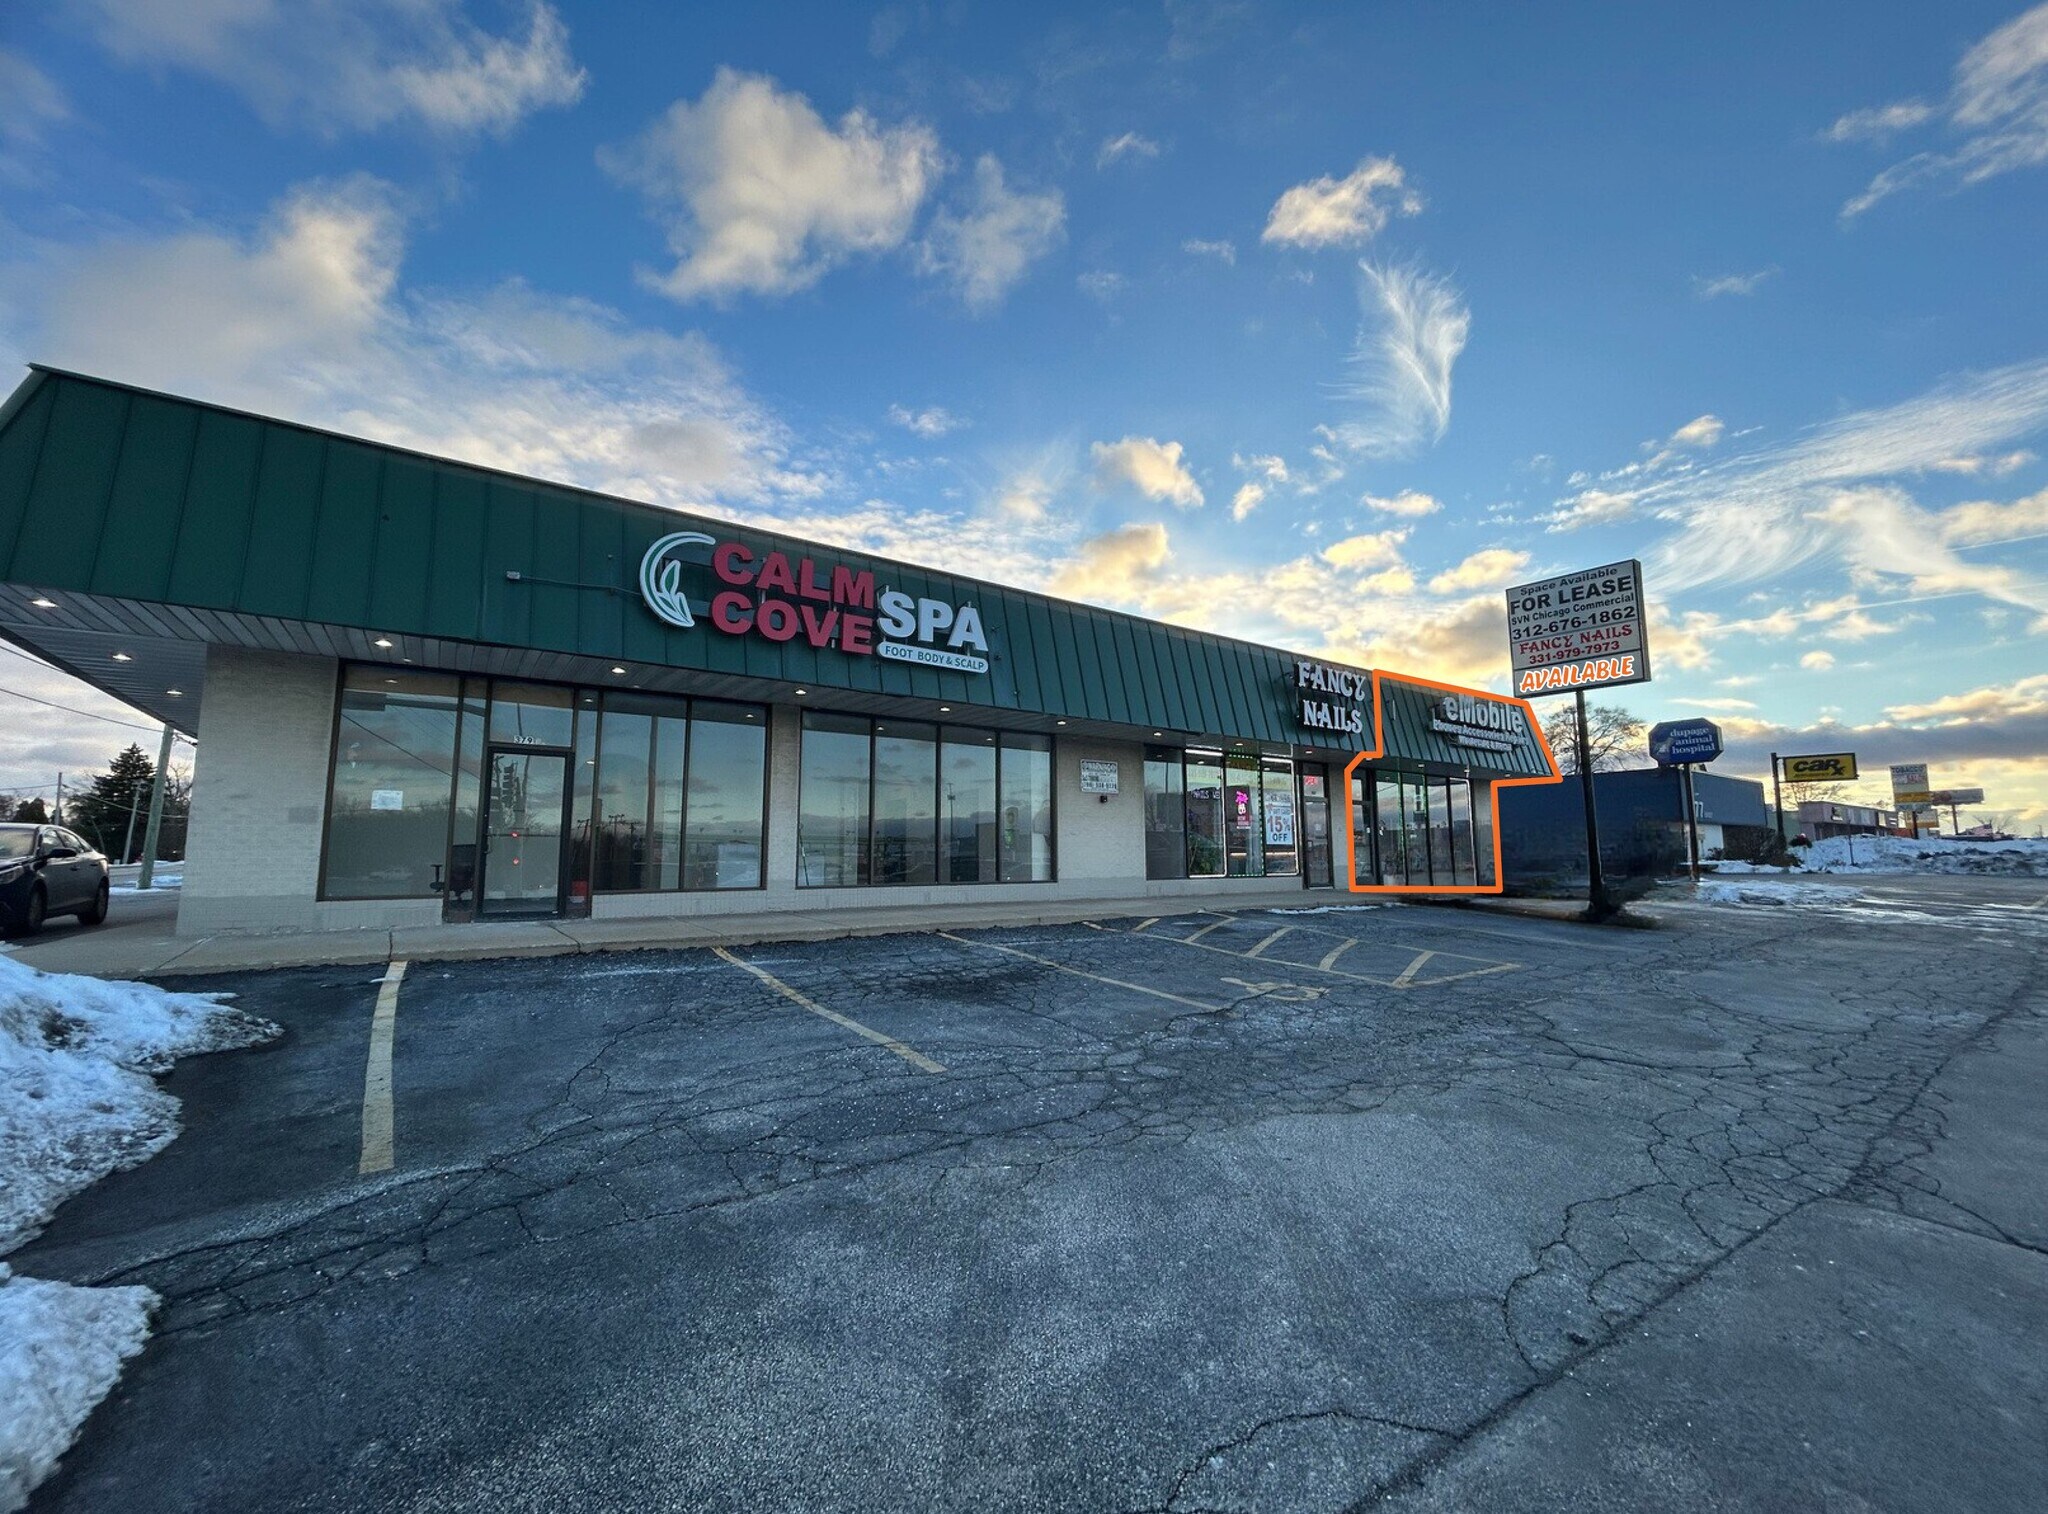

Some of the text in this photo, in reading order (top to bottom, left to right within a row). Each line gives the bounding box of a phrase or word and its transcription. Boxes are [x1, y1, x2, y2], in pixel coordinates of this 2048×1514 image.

[712, 543, 874, 609] CALM
[1520, 567, 1618, 596] Space Available
[1510, 575, 1632, 615] FOR LEASE
[1511, 593, 1634, 626] SVN Chicago Commercial
[711, 591, 874, 656] COVE
[877, 591, 989, 652] SPA
[1512, 606, 1635, 640] 312-676-1862
[1520, 624, 1633, 655] FANCY NAILS
[1529, 641, 1620, 665] 331-979-7973
[885, 645, 985, 670] FOOT BODY & SCALP
[1297, 661, 1366, 701] FANCY
[1303, 699, 1363, 734] NAILS
[1443, 693, 1523, 733] eMobile
[1670, 728, 1709, 737] dupage
[1672, 743, 1715, 754] hospital
[1676, 735, 1713, 745] animal
[1272, 833, 1287, 842] OFF
